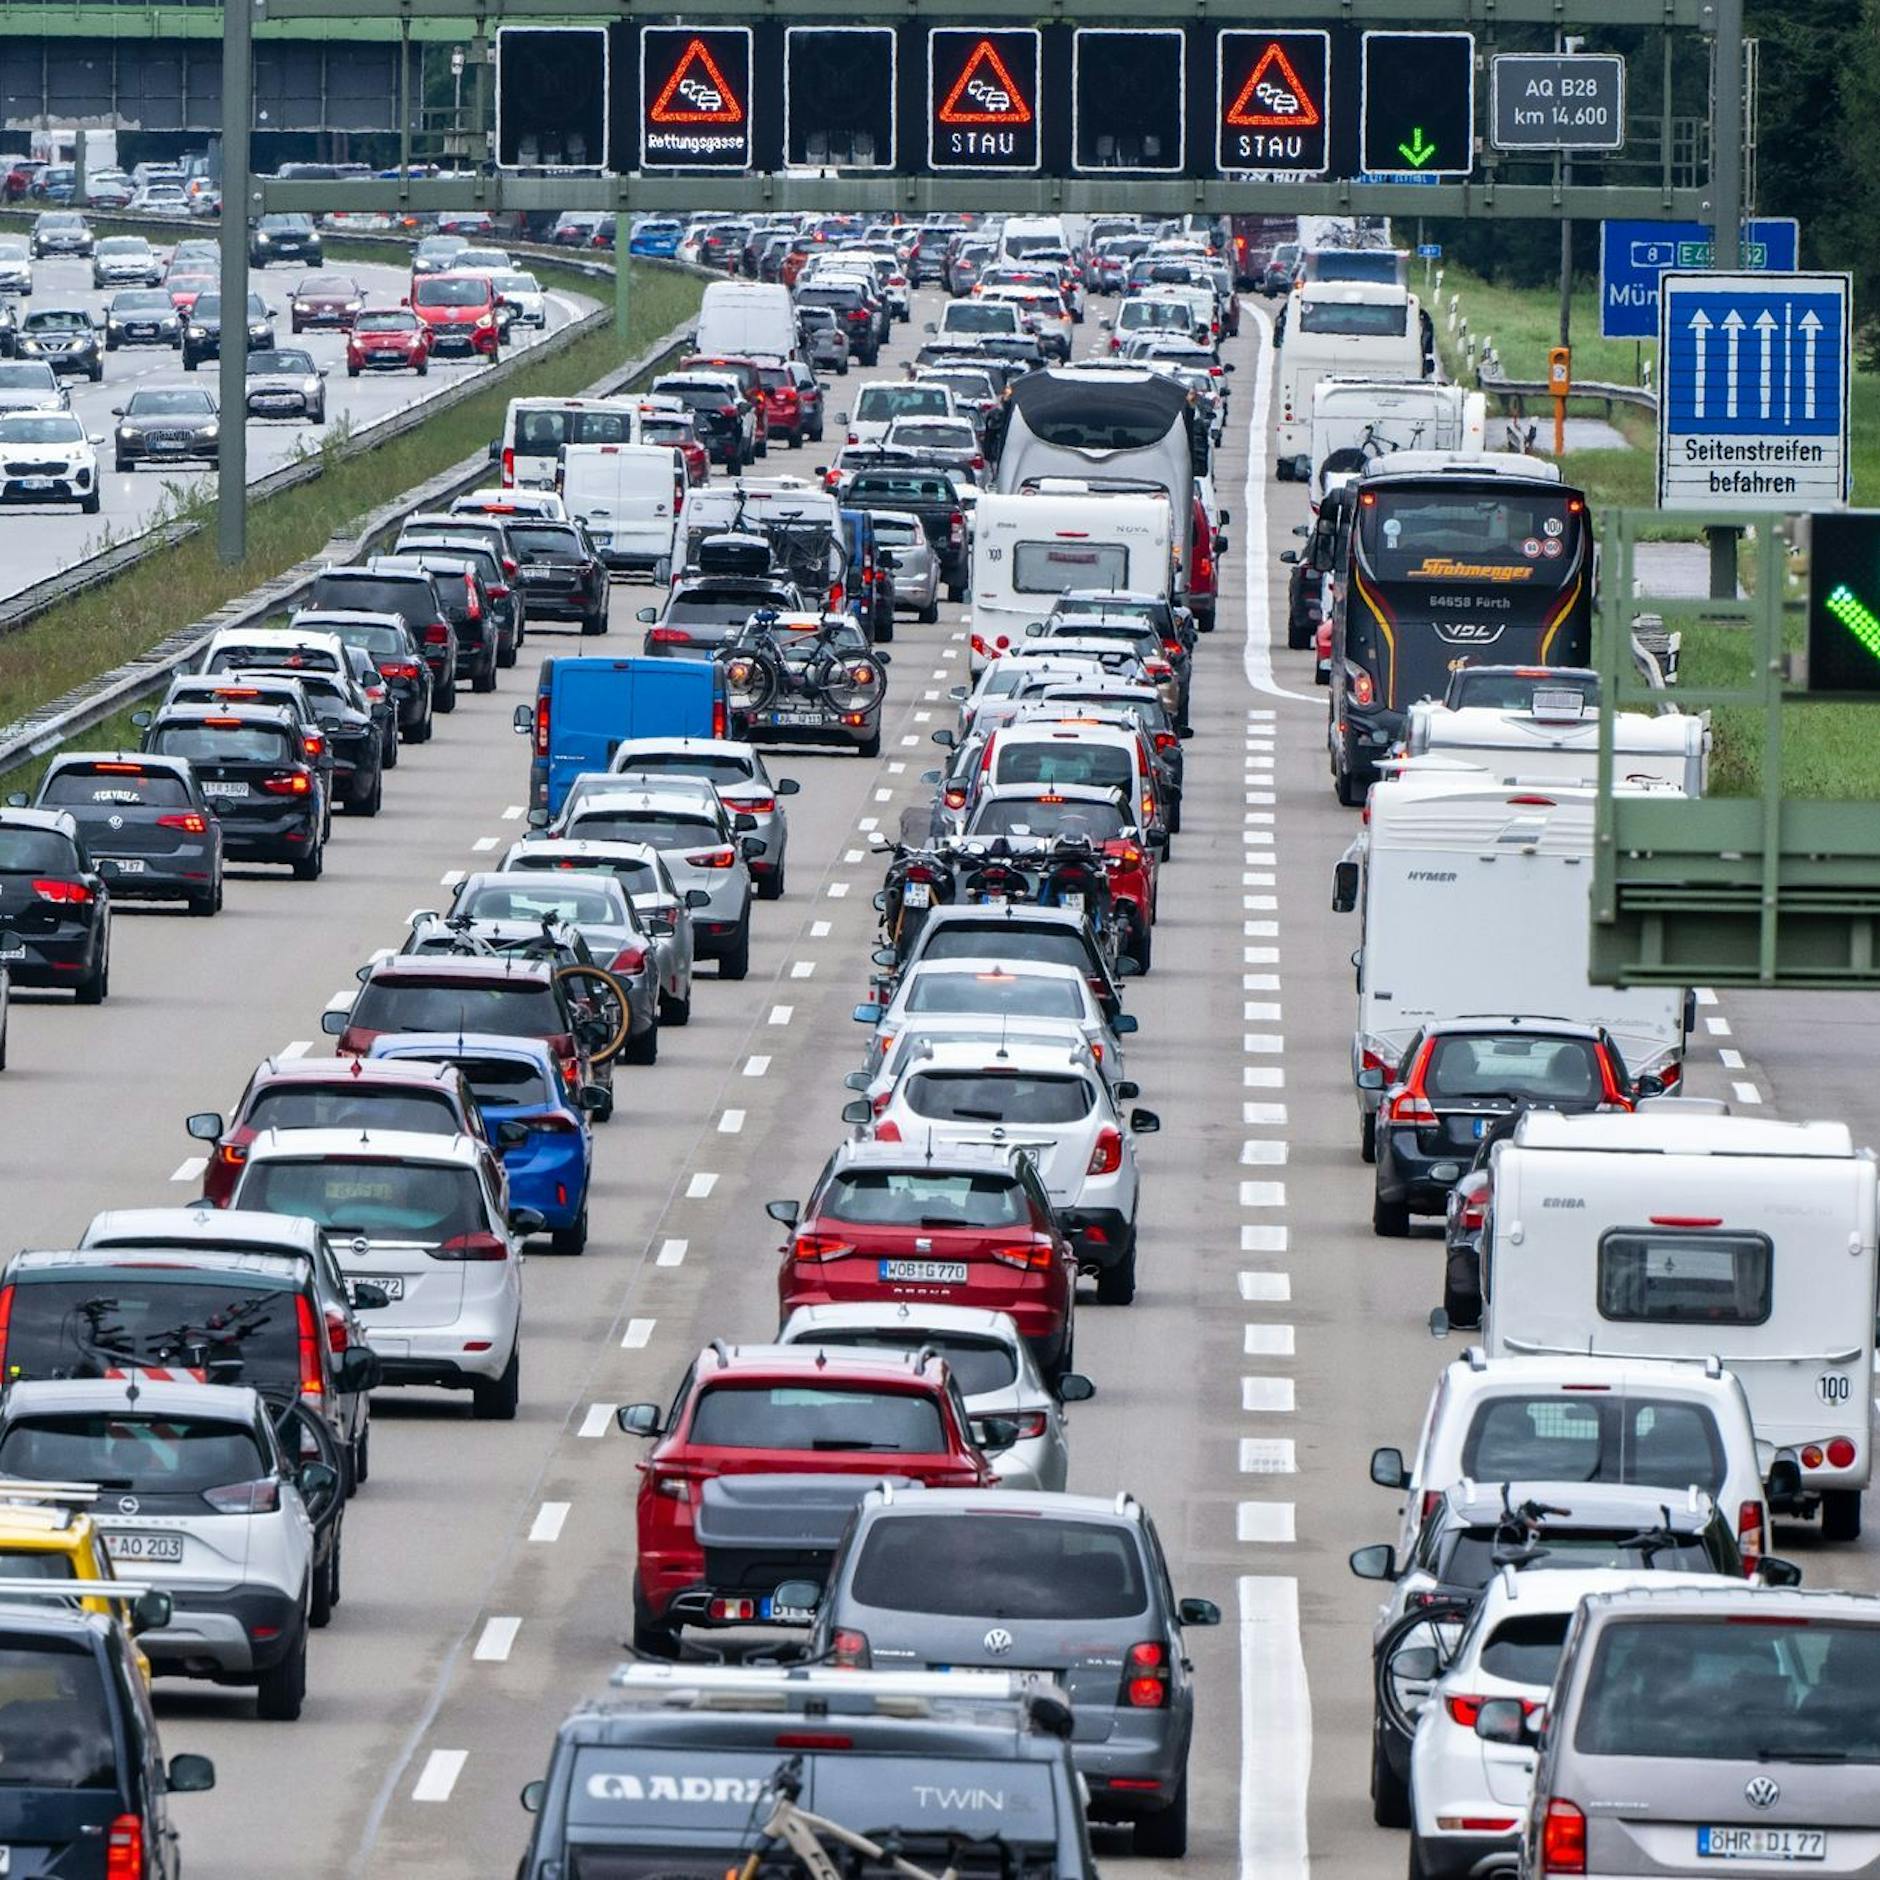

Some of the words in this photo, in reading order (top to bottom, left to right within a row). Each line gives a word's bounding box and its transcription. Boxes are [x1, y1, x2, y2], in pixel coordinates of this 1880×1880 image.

[1525, 79, 1554, 97] AQ
[1561, 79, 1598, 97] B28
[1514, 107, 1545, 125] km
[1552, 107, 1607, 125] 14.600
[648, 133, 745, 154] Rettungsgasse
[951, 132, 1014, 154] STAU
[1239, 135, 1301, 157] STAU
[1647, 247, 1659, 262] 8
[1686, 439, 1822, 461] Seitenstreifen
[1710, 471, 1795, 493] befahren
[1408, 871, 1457, 882] HYMER
[1543, 1198, 1585, 1209] ERIBA
[888, 1263, 915, 1277] WOB
[926, 1264, 935, 1277] G
[938, 1265, 965, 1279] 770
[1821, 1377, 1849, 1399] 100
[120, 1538, 143, 1555] AO
[147, 1539, 179, 1556] 203
[912, 1786, 1003, 1810] TWIN
[1711, 1830, 1751, 1851] ÖHR
[1767, 1833, 1790, 1852] DI
[1799, 1834, 1822, 1853] 77
